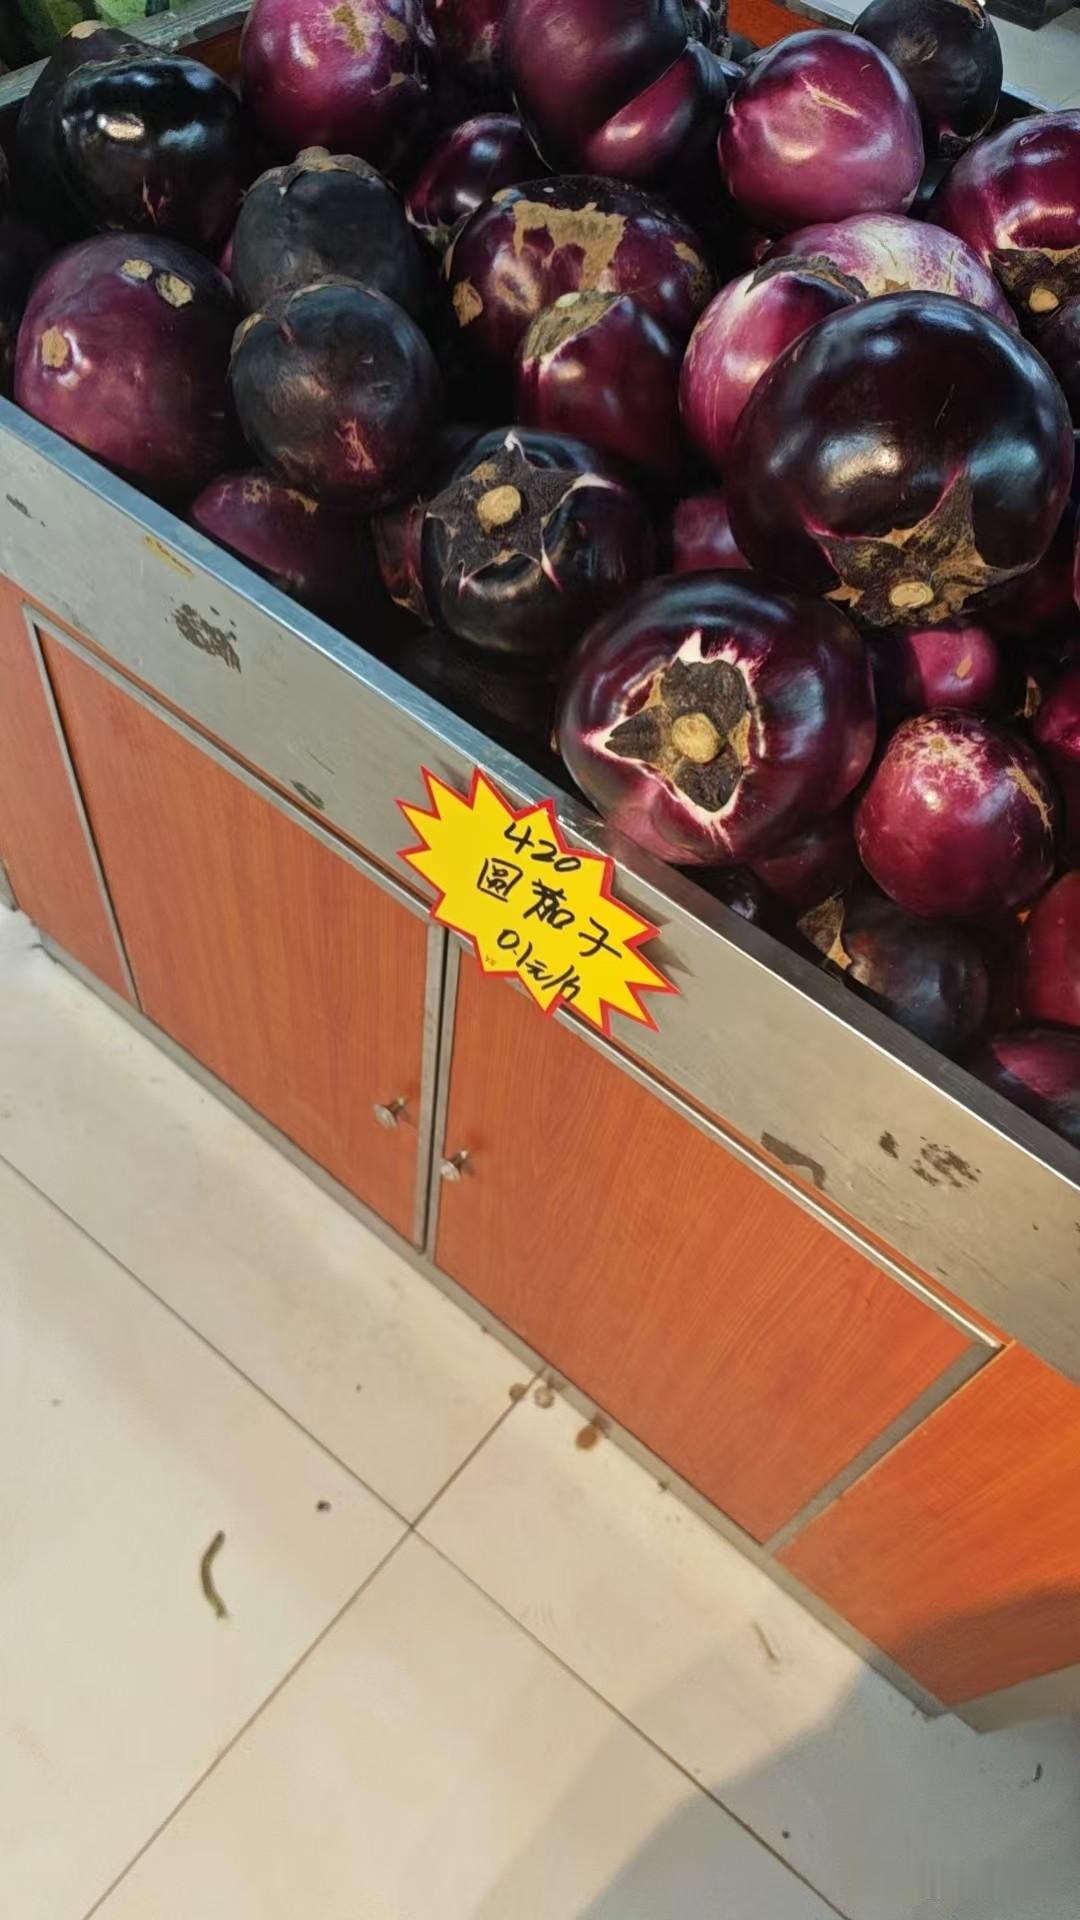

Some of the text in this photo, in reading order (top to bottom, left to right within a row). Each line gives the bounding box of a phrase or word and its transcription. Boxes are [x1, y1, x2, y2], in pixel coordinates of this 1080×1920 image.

[504, 822, 581, 872] 420
[477, 857, 622, 959] 圆茄子
